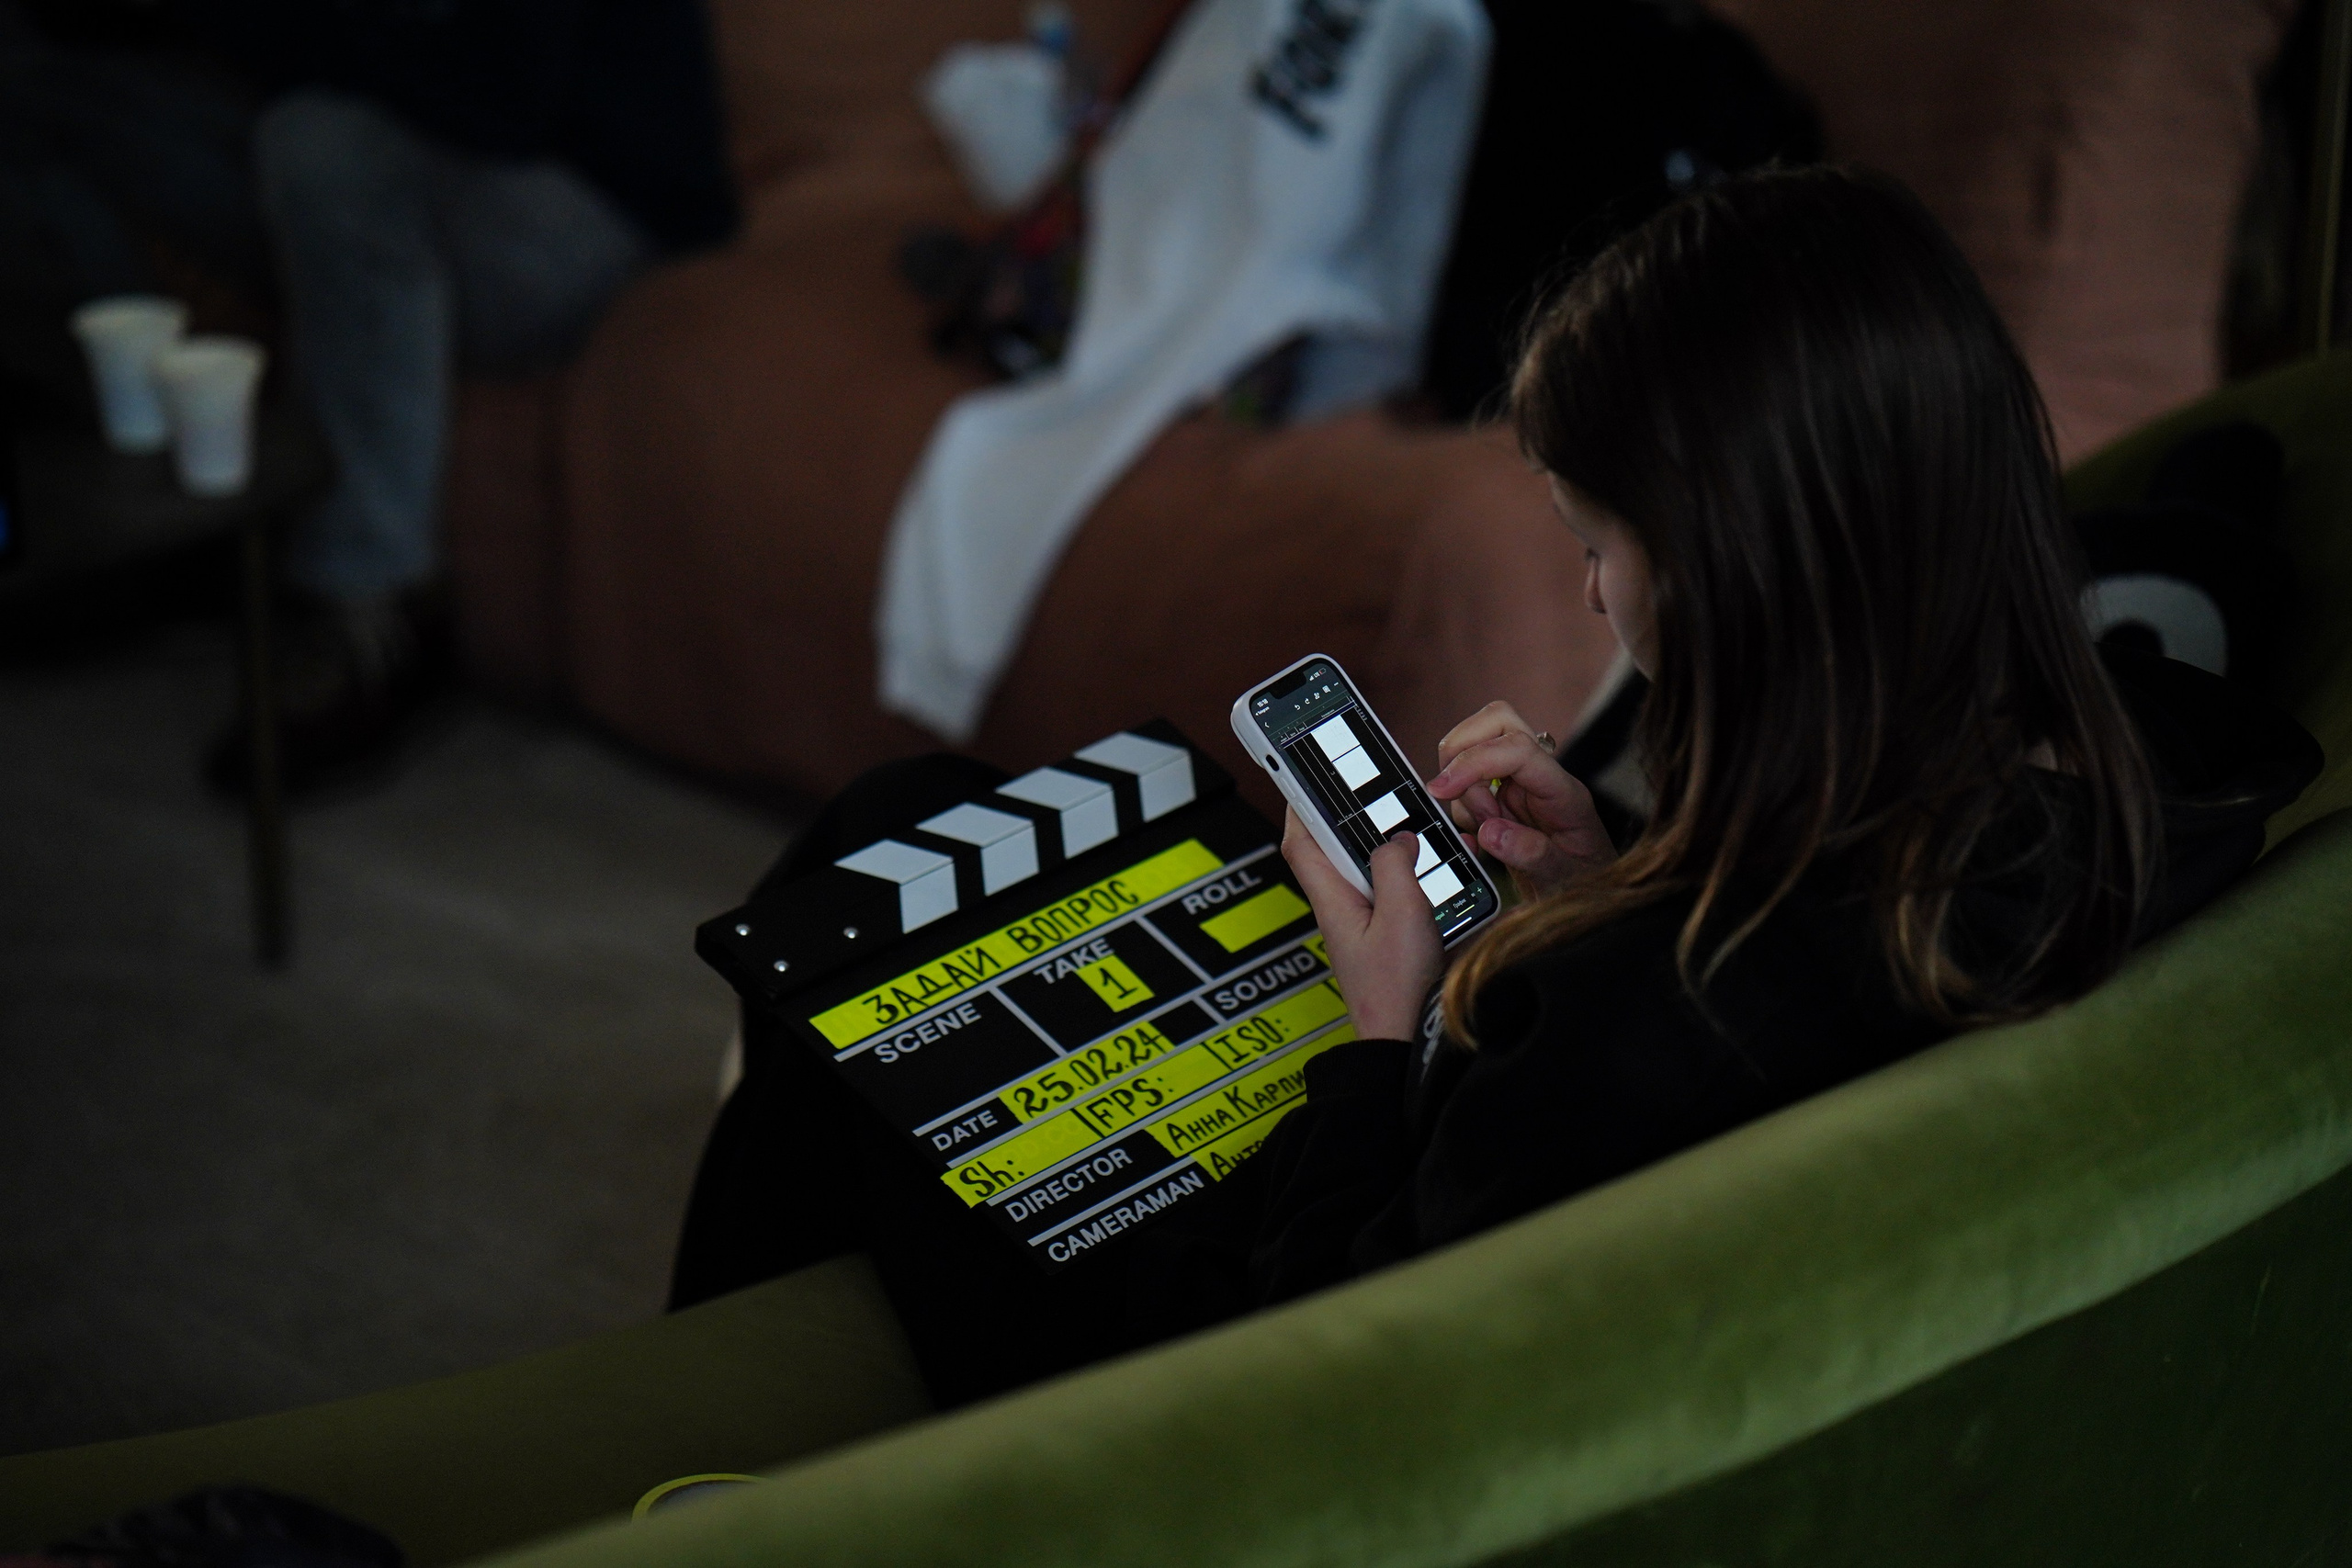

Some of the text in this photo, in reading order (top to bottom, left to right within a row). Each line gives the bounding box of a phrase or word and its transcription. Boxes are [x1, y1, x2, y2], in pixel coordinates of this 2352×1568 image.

[1181, 870, 1263, 916] ROLL
[862, 879, 1139, 1025] ЗАДАЙ ВОПРОС
[1033, 936, 1116, 985] TAKE
[1100, 967, 1138, 999] 1
[1214, 951, 1317, 1011] SOUND
[874, 1001, 983, 1064] SCENE
[1013, 1027, 1167, 1119] 25.02.24
[931, 1109, 1000, 1152] DATE
[959, 1016, 1290, 1199] Sh: FPS: ISO:
[1004, 1147, 1135, 1223] DIRECTOR
[1047, 1169, 1206, 1263] CAMERAMAN
